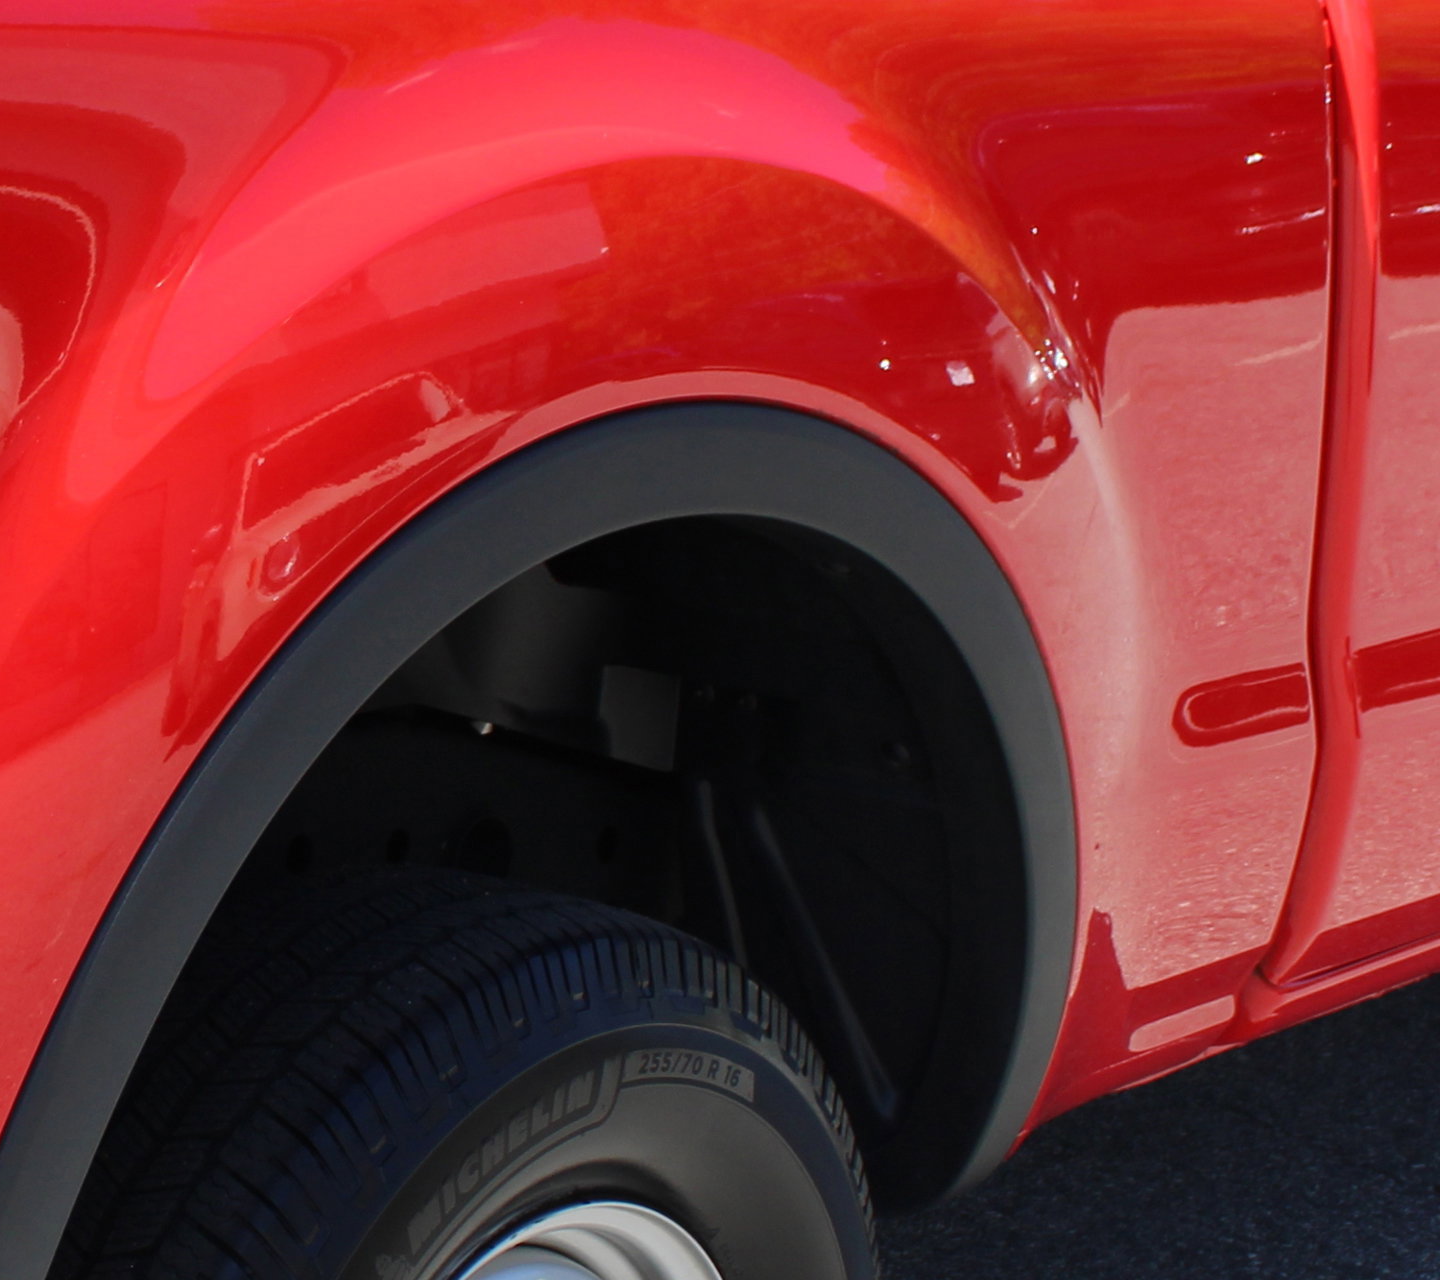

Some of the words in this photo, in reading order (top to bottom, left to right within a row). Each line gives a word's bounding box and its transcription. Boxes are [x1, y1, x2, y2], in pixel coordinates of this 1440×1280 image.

[638, 1051, 703, 1075] 255/70
[707, 1059, 720, 1079] R
[723, 1064, 742, 1088] 16
[405, 1068, 597, 1254] MICHELIN
